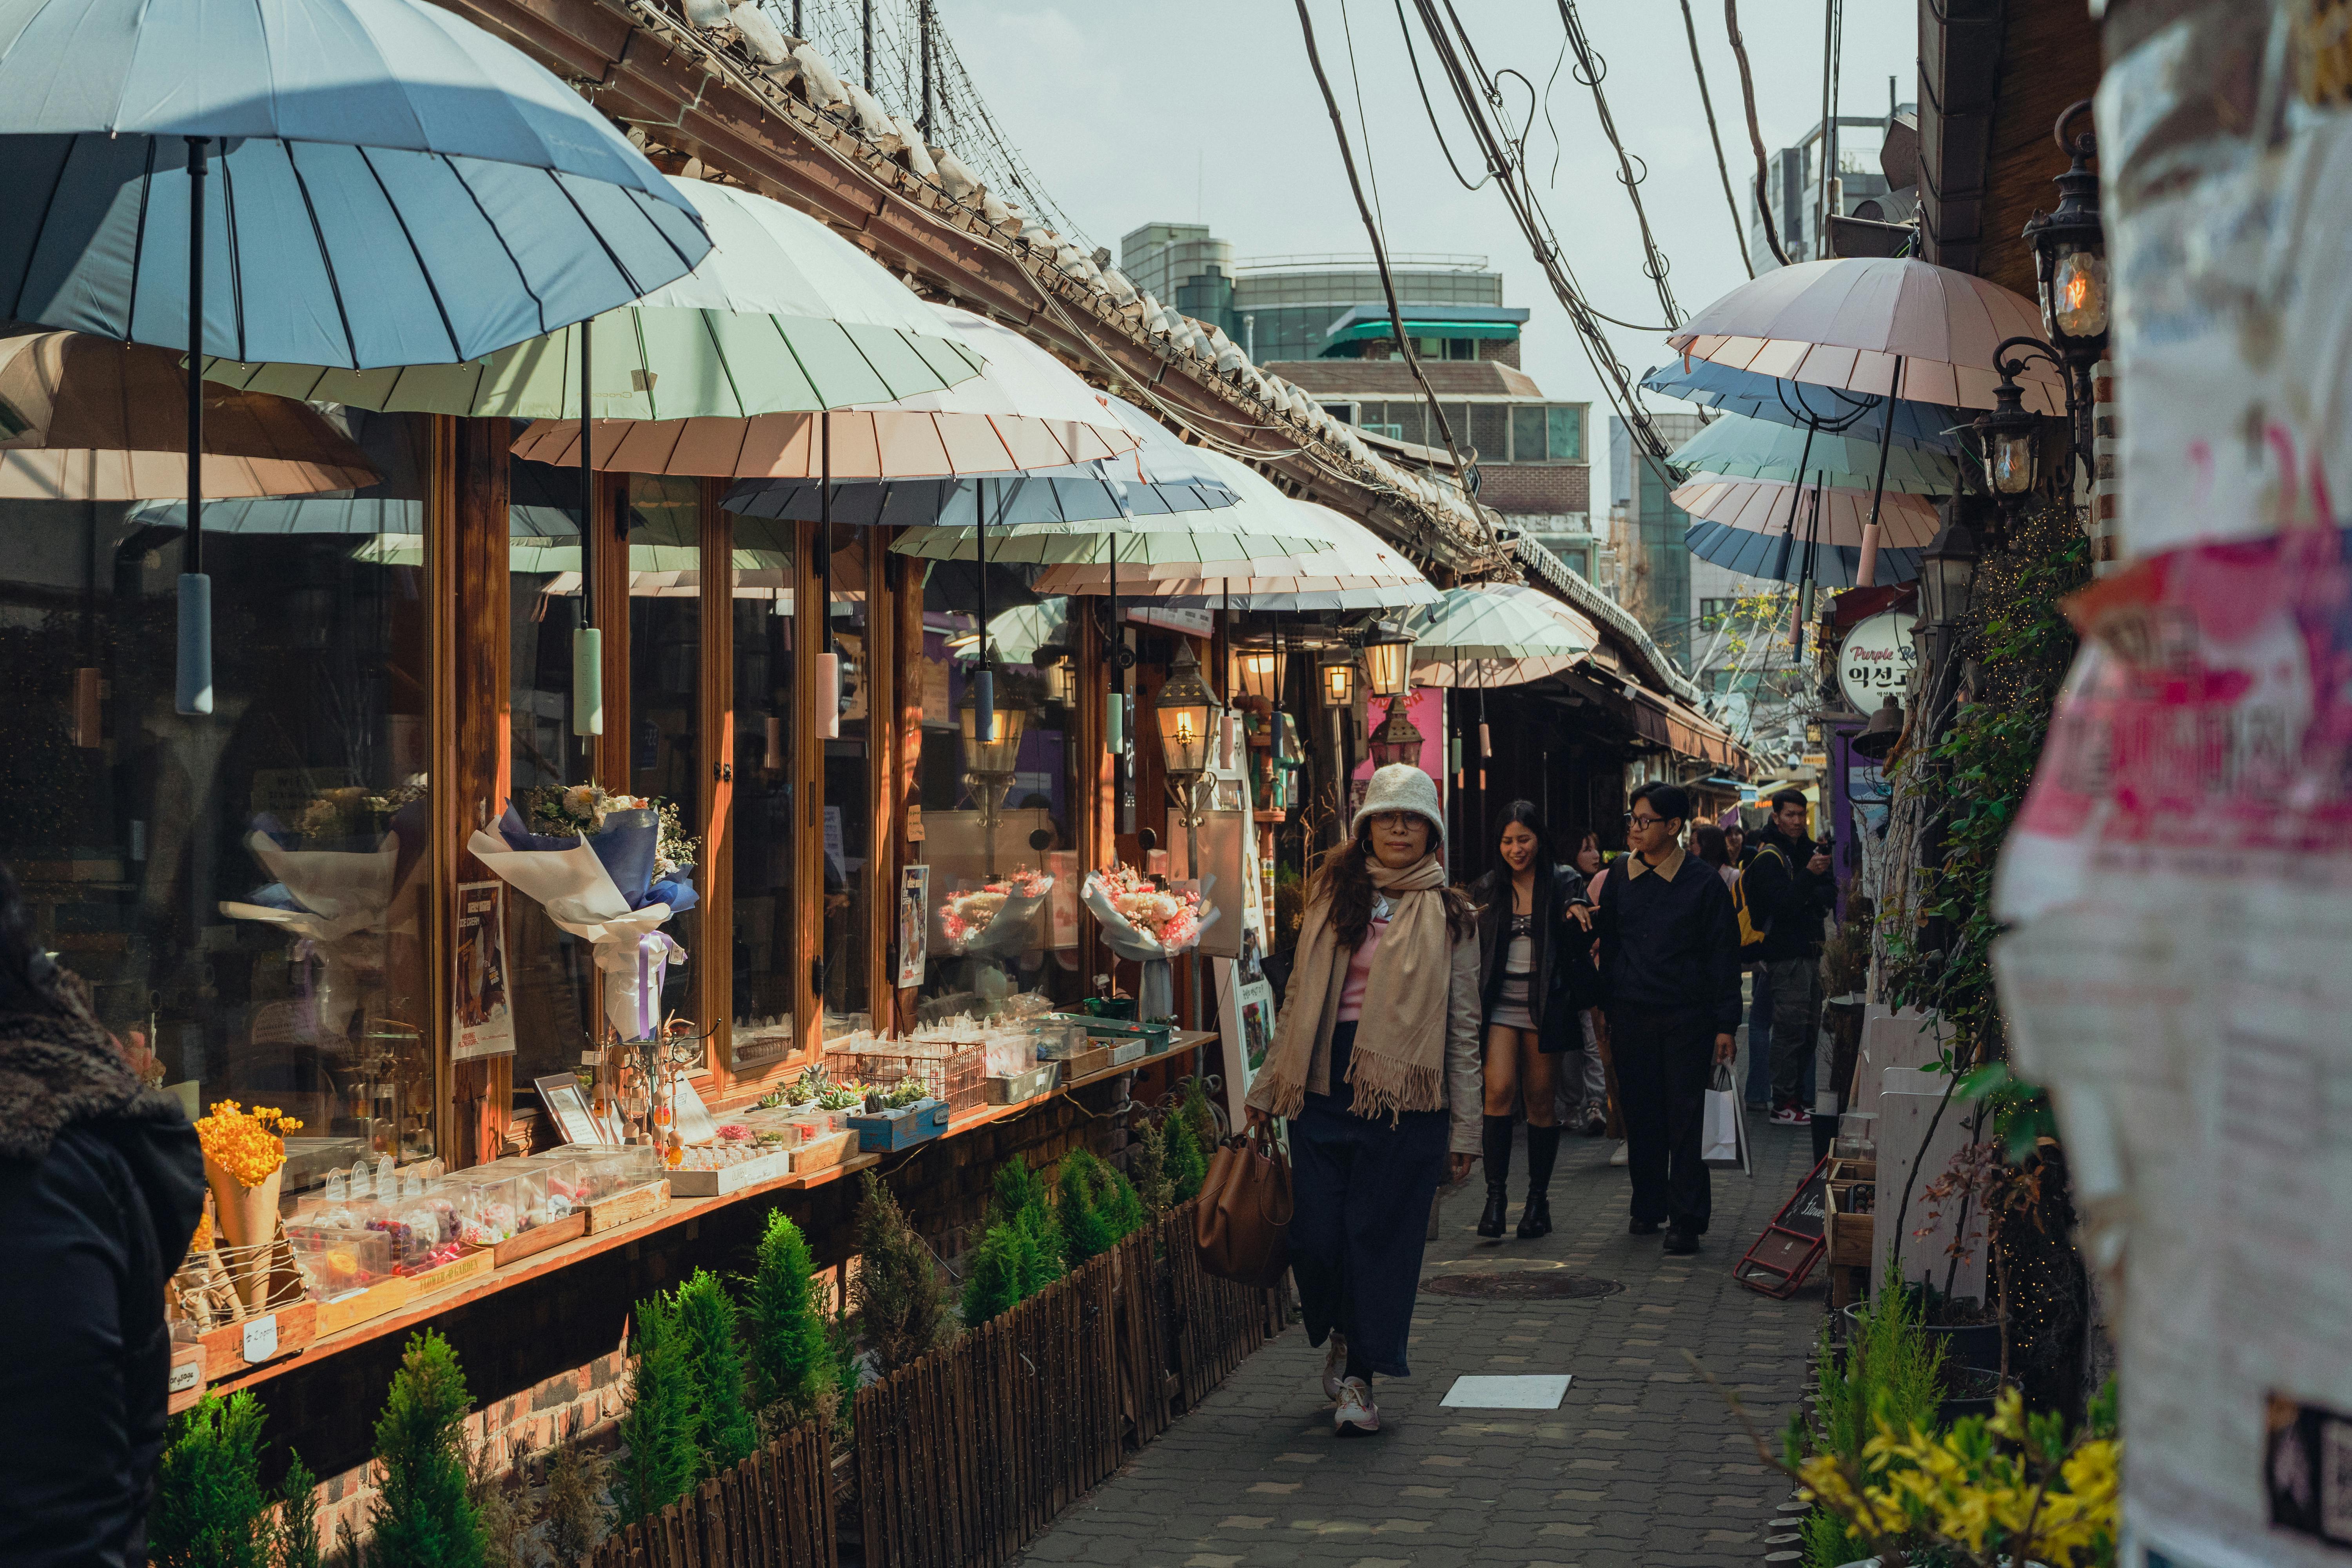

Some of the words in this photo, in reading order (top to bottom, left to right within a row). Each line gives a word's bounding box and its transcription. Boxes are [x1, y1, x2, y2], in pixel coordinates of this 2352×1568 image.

[1850, 646, 1894, 664] Purple
[467, 916, 480, 926] CREAM
[462, 1032, 475, 1041] MADANG
[732, 1167, 744, 1181] OLIVES
[420, 1271, 445, 1291] FLOWER
[454, 1258, 479, 1276] GARDEN
